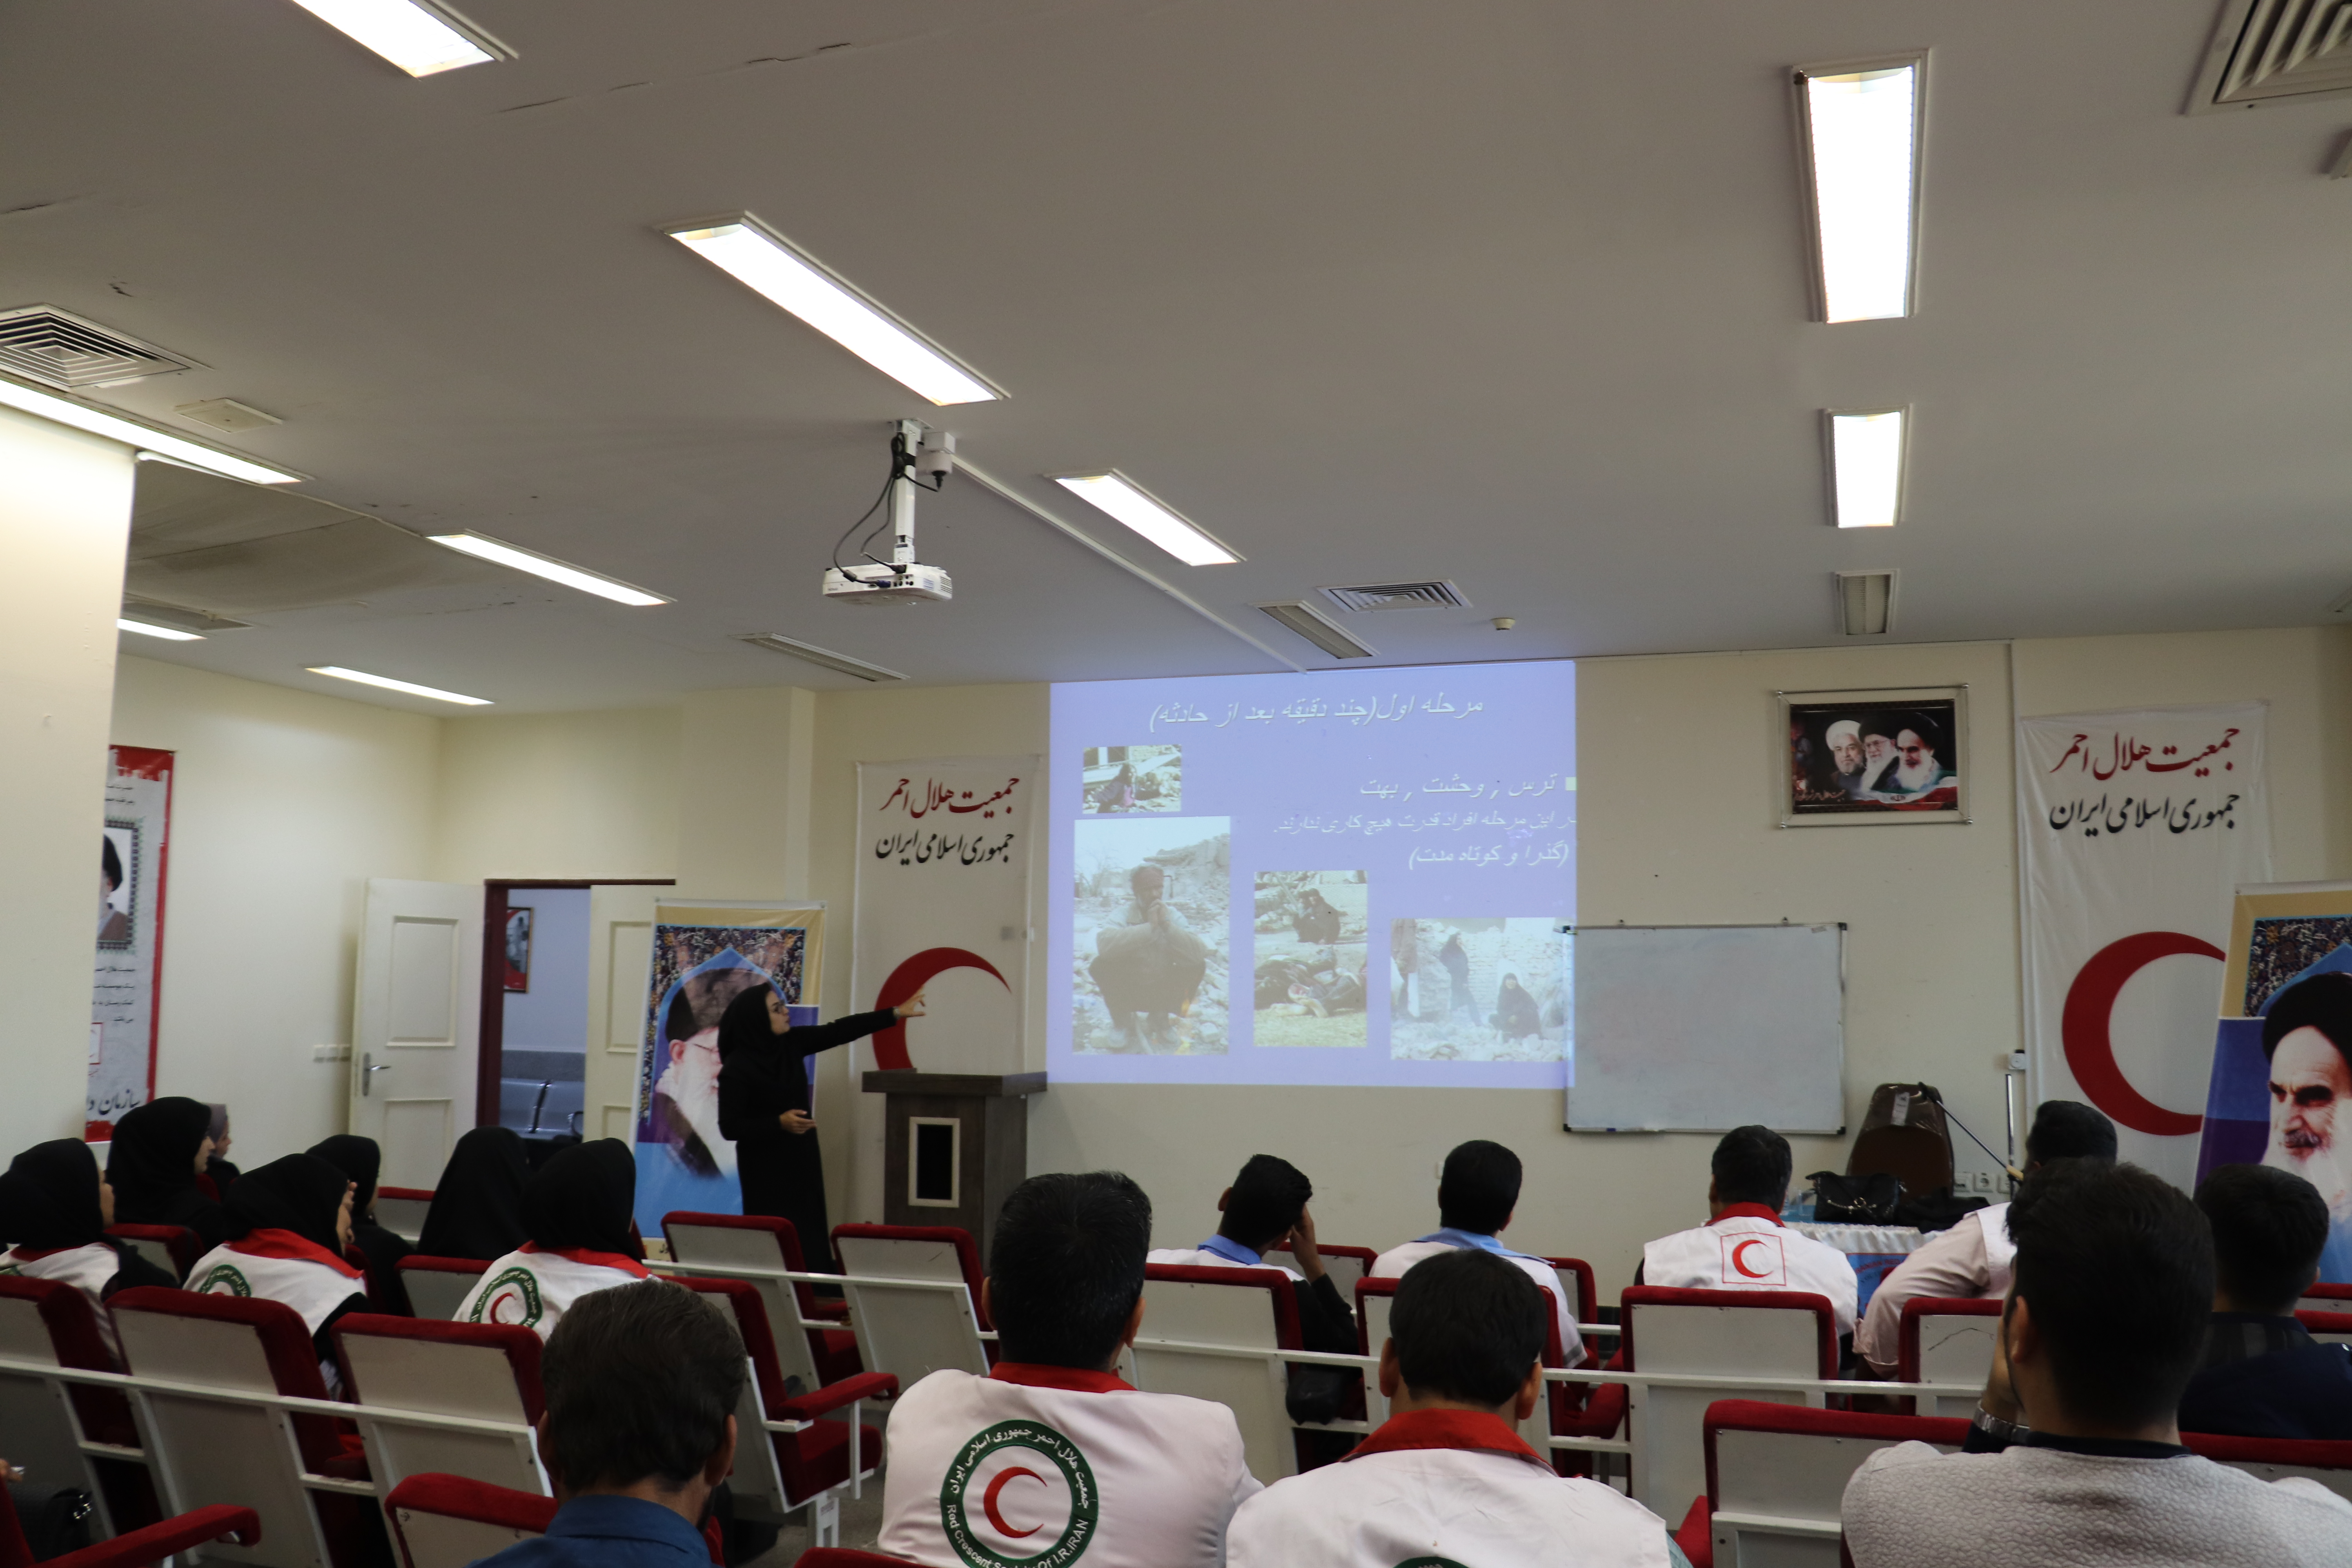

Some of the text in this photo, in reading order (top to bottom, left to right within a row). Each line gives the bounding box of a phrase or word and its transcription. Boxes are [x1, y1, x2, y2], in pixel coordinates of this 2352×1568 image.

[1215, 702, 1240, 728] از
[1245, 706, 1276, 725] بعد
[1281, 698, 1328, 725] دقیقه
[1421, 692, 1484, 719] مرحله
[2049, 728, 2240, 780] جمعیت هلال احمر
[879, 777, 1020, 818] جمعیت هلال احمر
[1360, 780, 1399, 799] بهت
[1423, 773, 1485, 798] وحشت
[1508, 773, 1559, 797] ترس
[1442, 812, 1479, 831] افراد
[1481, 810, 1527, 830] مرحله
[2049, 793, 2240, 837] جمهوری اسلامی ایران
[875, 829, 1014, 866] جمهوری اسلامی ایران
[1458, 844, 1503, 867] کوتاه
[1504, 852, 1519, 866] و
[949, 1428, 1089, 1509] جمعیت هلال احمر جمهوری اسلامی ایران
[955, 1530, 992, 1568] Crescent
